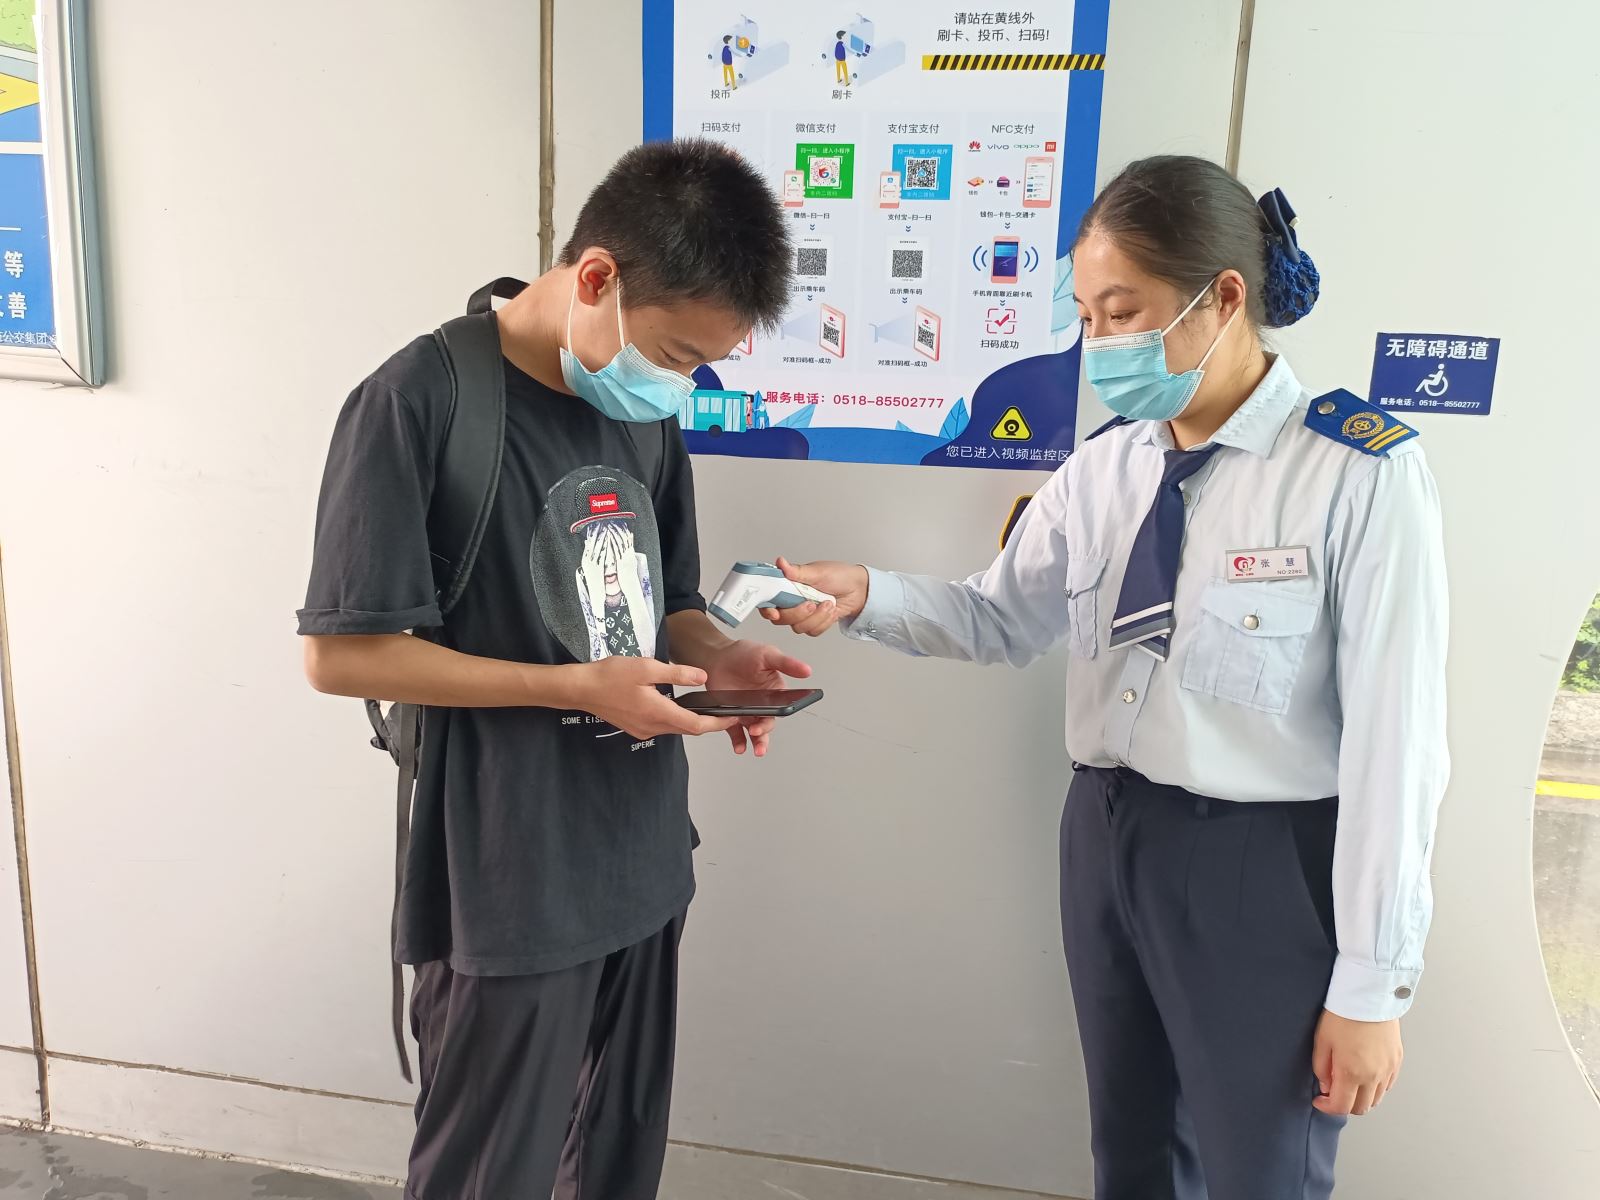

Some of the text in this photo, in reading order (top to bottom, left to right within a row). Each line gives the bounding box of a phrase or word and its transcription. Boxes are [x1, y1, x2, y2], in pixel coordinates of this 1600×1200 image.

[954, 12, 1035, 25] 请站在黄线外
[711, 89, 731, 100] 投币
[832, 90, 853, 100] 刷卡
[701, 122, 741, 133] 扫码支付
[795, 123, 836, 134] 微信支付
[887, 123, 940, 134] 支付宝支付
[991, 124, 1035, 135] NFC支付
[793, 285, 826, 293] 出示乘车码
[889, 287, 923, 295] 出示乘车码
[980, 339, 1019, 349] 扫码成功
[1386, 338, 1489, 360] 无障碍通道
[946, 445, 1071, 462] 您已进入视频监控区
[562, 716, 581, 725] SOME
